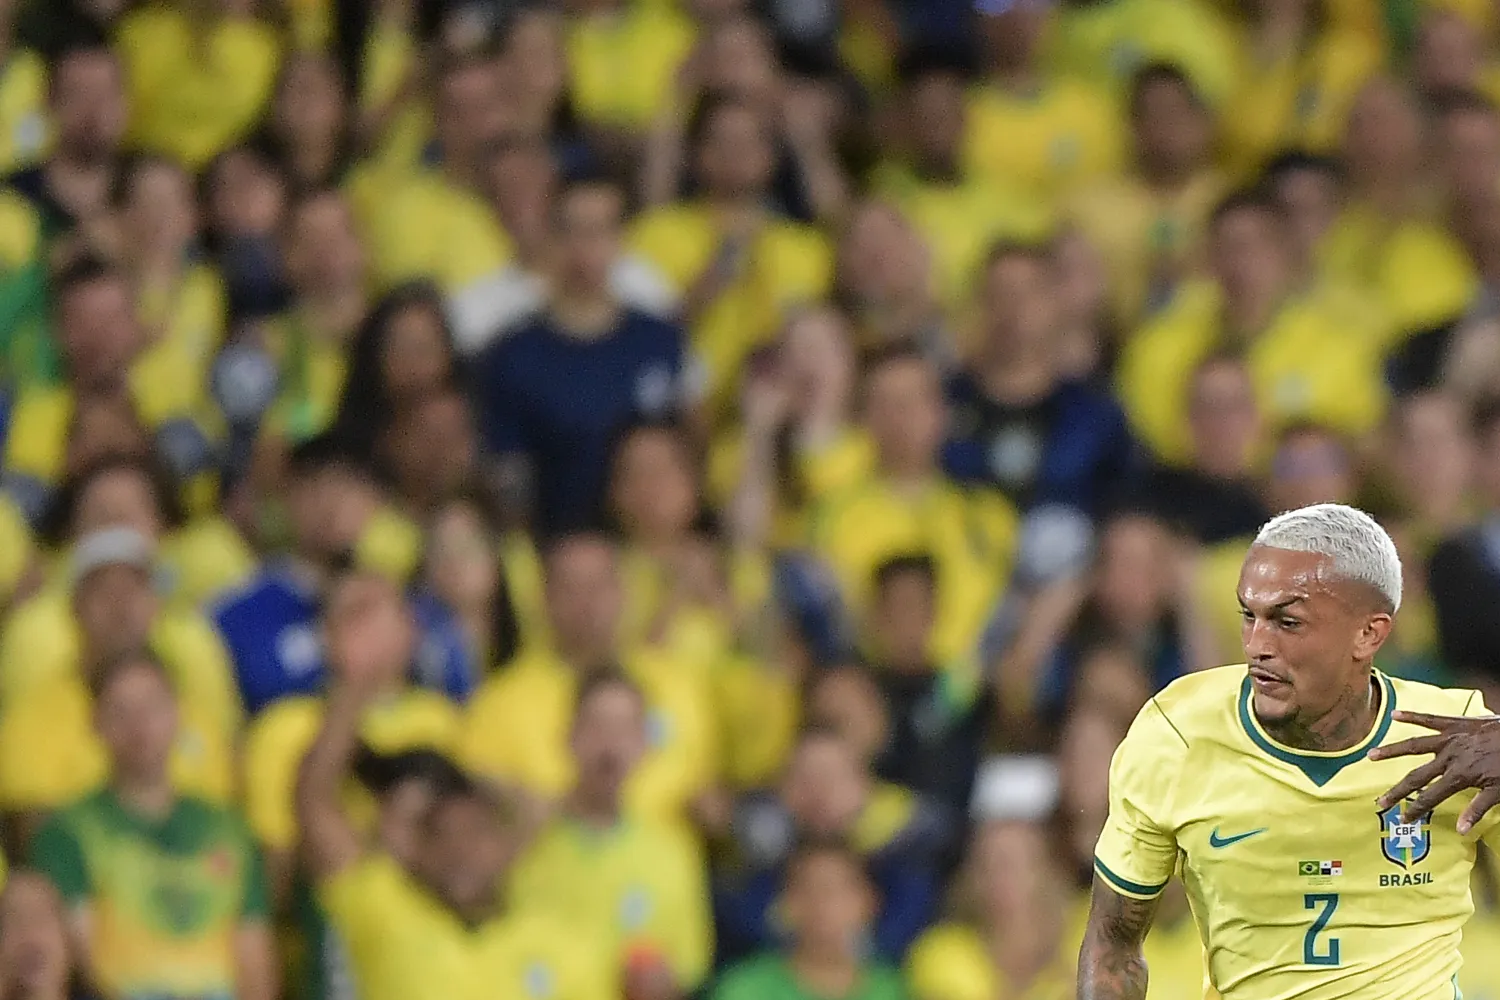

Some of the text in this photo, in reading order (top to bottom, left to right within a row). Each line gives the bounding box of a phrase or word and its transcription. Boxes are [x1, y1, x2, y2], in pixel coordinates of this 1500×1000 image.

[1395, 826, 1416, 836] CBF
[1379, 872, 1434, 887] BRASIL
[1304, 893, 1340, 965] 2
